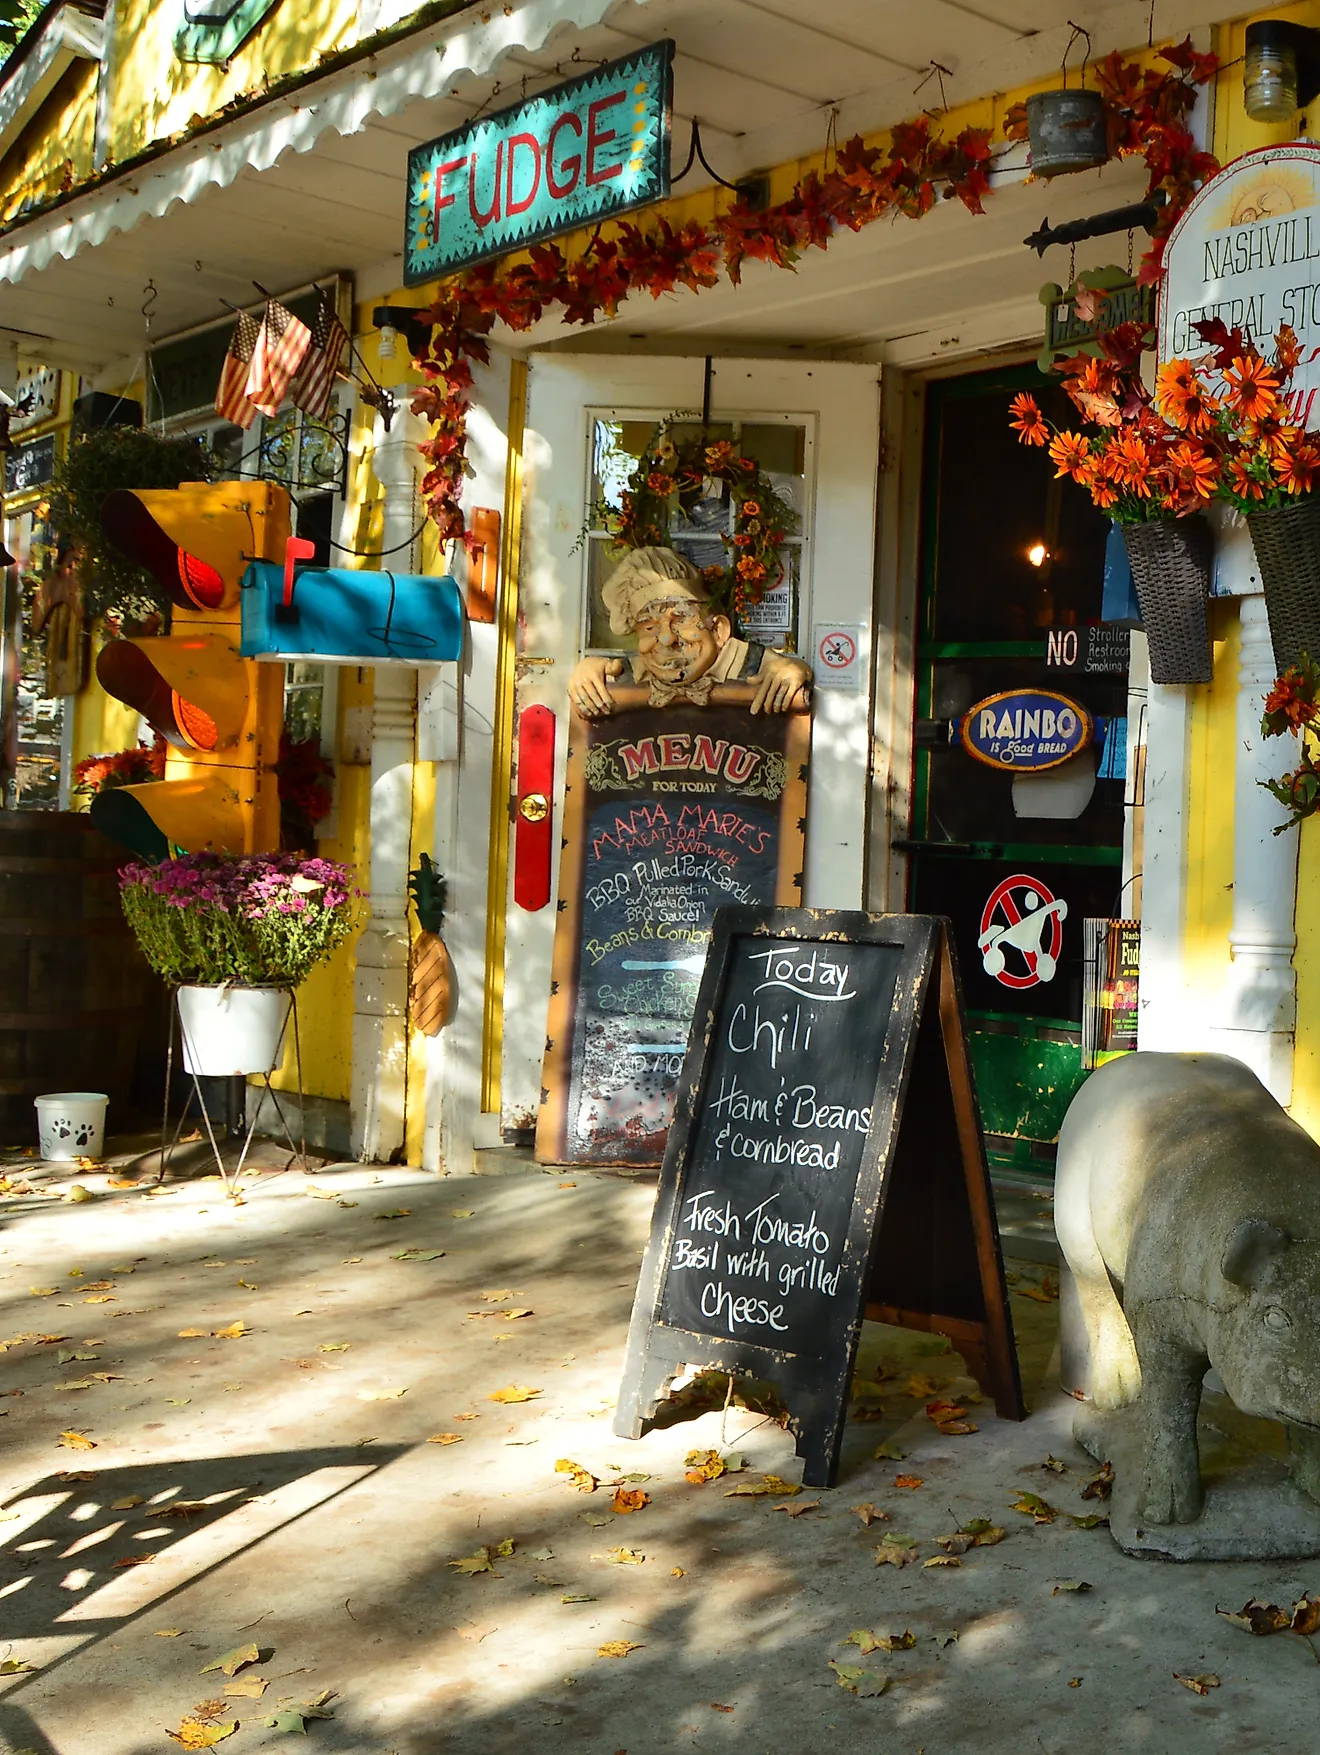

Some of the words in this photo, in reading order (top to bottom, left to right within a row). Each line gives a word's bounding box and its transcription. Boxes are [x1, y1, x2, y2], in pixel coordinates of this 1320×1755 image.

[432, 90, 627, 244] FUDGE
[1053, 292, 1140, 341] WELOME
[762, 593, 788, 604] OKING
[1047, 630, 1078, 666] NO
[1085, 657, 1122, 673] Smoking
[979, 708, 1077, 740] RAINBO
[618, 733, 760, 785] MENU
[990, 741, 1000, 753] IS
[1000, 738, 1035, 764] good
[1037, 742, 1067, 754] BREAD
[653, 781, 678, 792] FOR
[680, 781, 717, 793] TODAY
[593, 803, 671, 861] MAMA
[677, 804, 771, 854] MARIE'S
[625, 826, 708, 856] MEATLOAF
[664, 840, 740, 868] SANDWICH
[585, 873, 630, 912] BBQ
[632, 856, 680, 886] Pulled
[639, 883, 693, 900] Marinated
[698, 884, 709, 895] in
[625, 906, 654, 923] BBQ
[658, 908, 700, 922] Sauce!
[644, 895, 677, 909] Vidalia
[677, 895, 706, 914] Onion
[585, 925, 639, 966] Beans
[640, 919, 654, 940] &
[1121, 942, 1141, 967] Fud
[748, 947, 850, 996] Today
[598, 977, 655, 1009] Sweet
[624, 989, 683, 1019] Chicken
[728, 1003, 816, 1070] Chili
[611, 1055, 647, 1076] AND
[653, 1054, 682, 1075] MO
[709, 1075, 770, 1122] Ham
[791, 1084, 872, 1133] Beans
[684, 1190, 740, 1241] Fresh
[745, 1192, 830, 1254] Tomato
[672, 1239, 719, 1270] Basil
[727, 1248, 770, 1283] with
[778, 1256, 841, 1297] grilled
